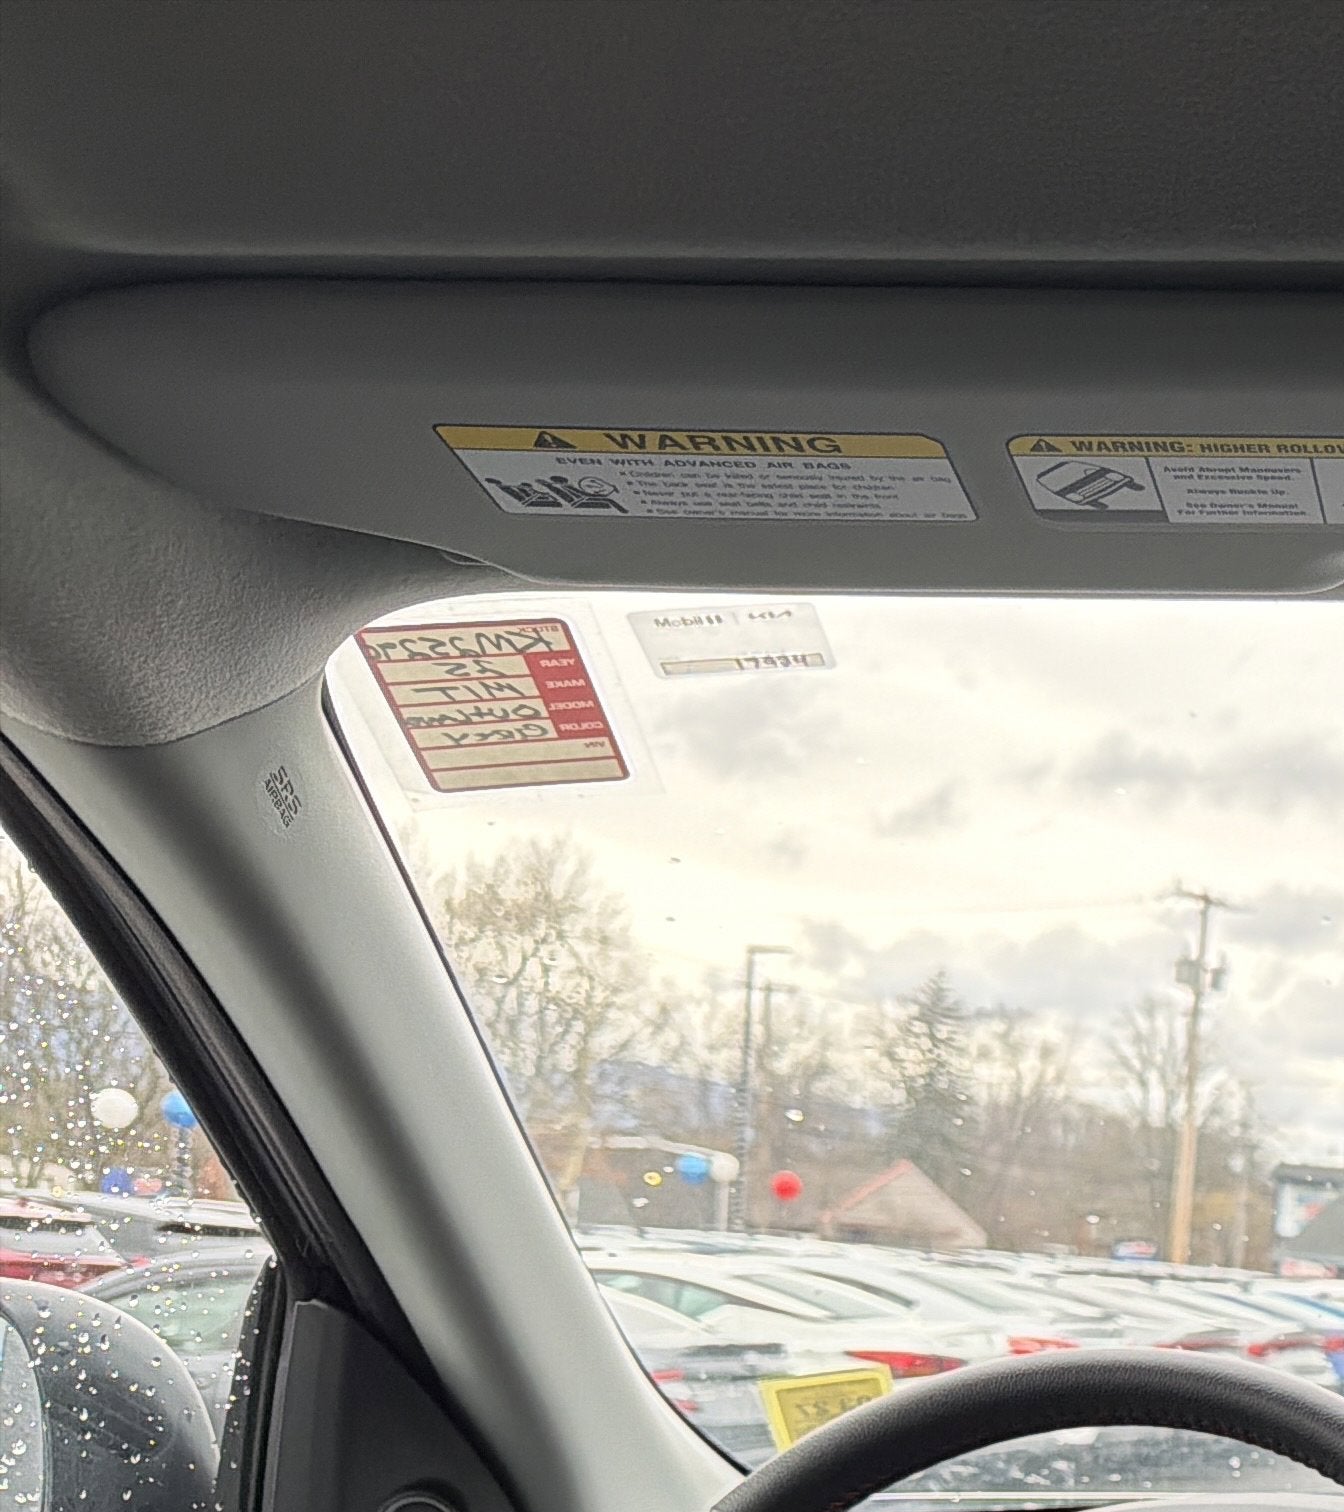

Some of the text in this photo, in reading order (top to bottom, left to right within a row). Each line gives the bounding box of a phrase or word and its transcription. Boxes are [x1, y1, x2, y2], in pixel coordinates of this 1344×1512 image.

[604, 432, 842, 454] WARNING
[1070, 439, 1194, 454] WARNING:
[1200, 441, 1274, 455] HIGHER
[556, 456, 851, 471] EVEN WITH ADVANCED AIR BAGS
[272, 765, 302, 815] SRS
[263, 778, 292, 829] AIRBAG
